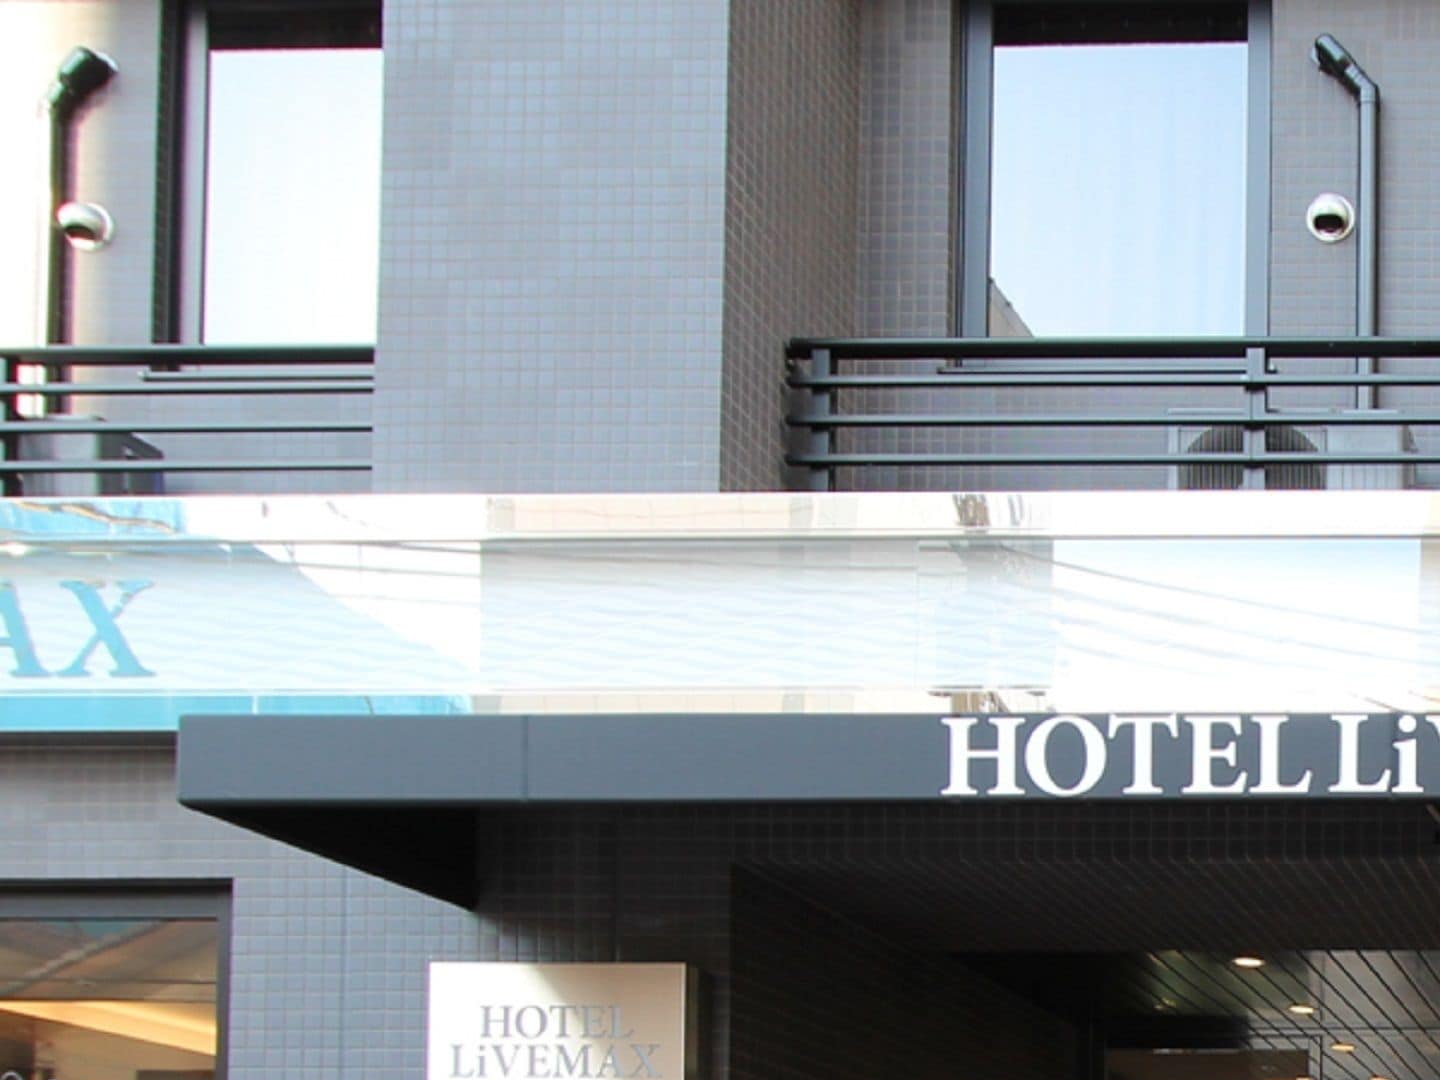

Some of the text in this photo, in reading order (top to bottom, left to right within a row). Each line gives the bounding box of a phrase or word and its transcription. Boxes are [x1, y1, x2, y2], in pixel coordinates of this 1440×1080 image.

[941, 714, 1312, 796] HOTEL
[480, 1004, 634, 1039] HOTEL
[449, 1044, 663, 1079] LiVEMAX
